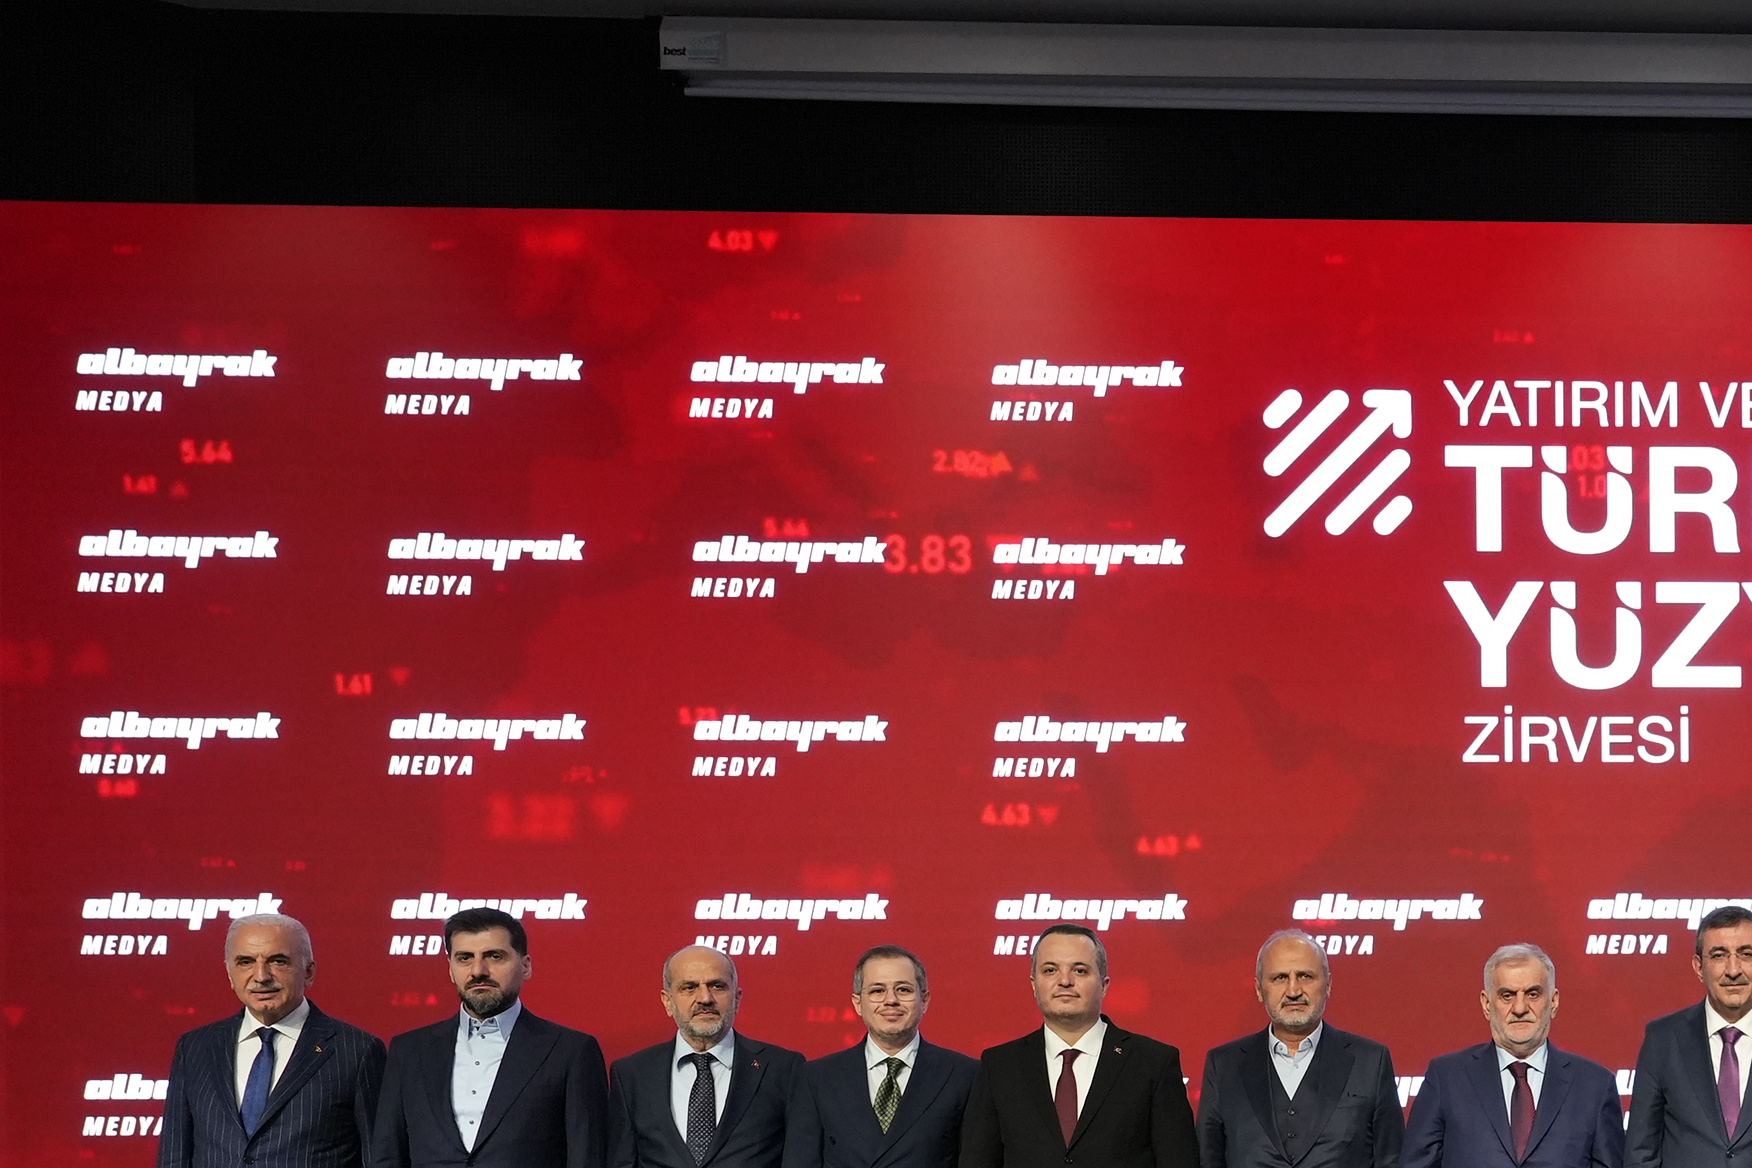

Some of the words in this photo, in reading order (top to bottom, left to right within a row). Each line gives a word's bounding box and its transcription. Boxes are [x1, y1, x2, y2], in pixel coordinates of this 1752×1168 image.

[77, 348, 277, 387] albayrak
[386, 352, 583, 390] albayrak
[691, 356, 885, 394] albayrak
[992, 359, 1184, 397] albayrak
[76, 391, 162, 411] MEDYA
[385, 395, 469, 415] MEDYA
[690, 398, 773, 418] MEDYA
[990, 401, 1073, 421] MEDYA
[1444, 379, 1677, 427] YATIRIM
[79, 530, 279, 568] albayrak
[388, 533, 585, 570] albayrak
[693, 536, 887, 573] albayrak
[882, 533, 972, 575] 3.83
[993, 538, 1185, 575] albayrak
[78, 573, 164, 592] MEDYA
[387, 575, 471, 595] MEDYA
[691, 578, 775, 597] MEDYA
[992, 580, 1074, 599] MEDYA
[81, 712, 280, 749] albayrak
[390, 713, 586, 750] albayrak
[694, 715, 888, 752] albayrak
[994, 716, 1186, 753] albayrak
[1463, 705, 1689, 763] ZİRVESİ
[79, 754, 166, 774] MEDYA
[388, 756, 472, 775] MEDYA
[692, 757, 776, 776] MEDYA
[993, 758, 1075, 777] MEDYA
[82, 893, 283, 930] albayrak
[695, 894, 889, 930] albayrak
[995, 894, 1187, 930] albayrak
[1293, 894, 1483, 930] albayrak
[81, 935, 167, 955] MEDYA
[390, 936, 448, 955] MED
[1586, 935, 1667, 954] MEDYA
